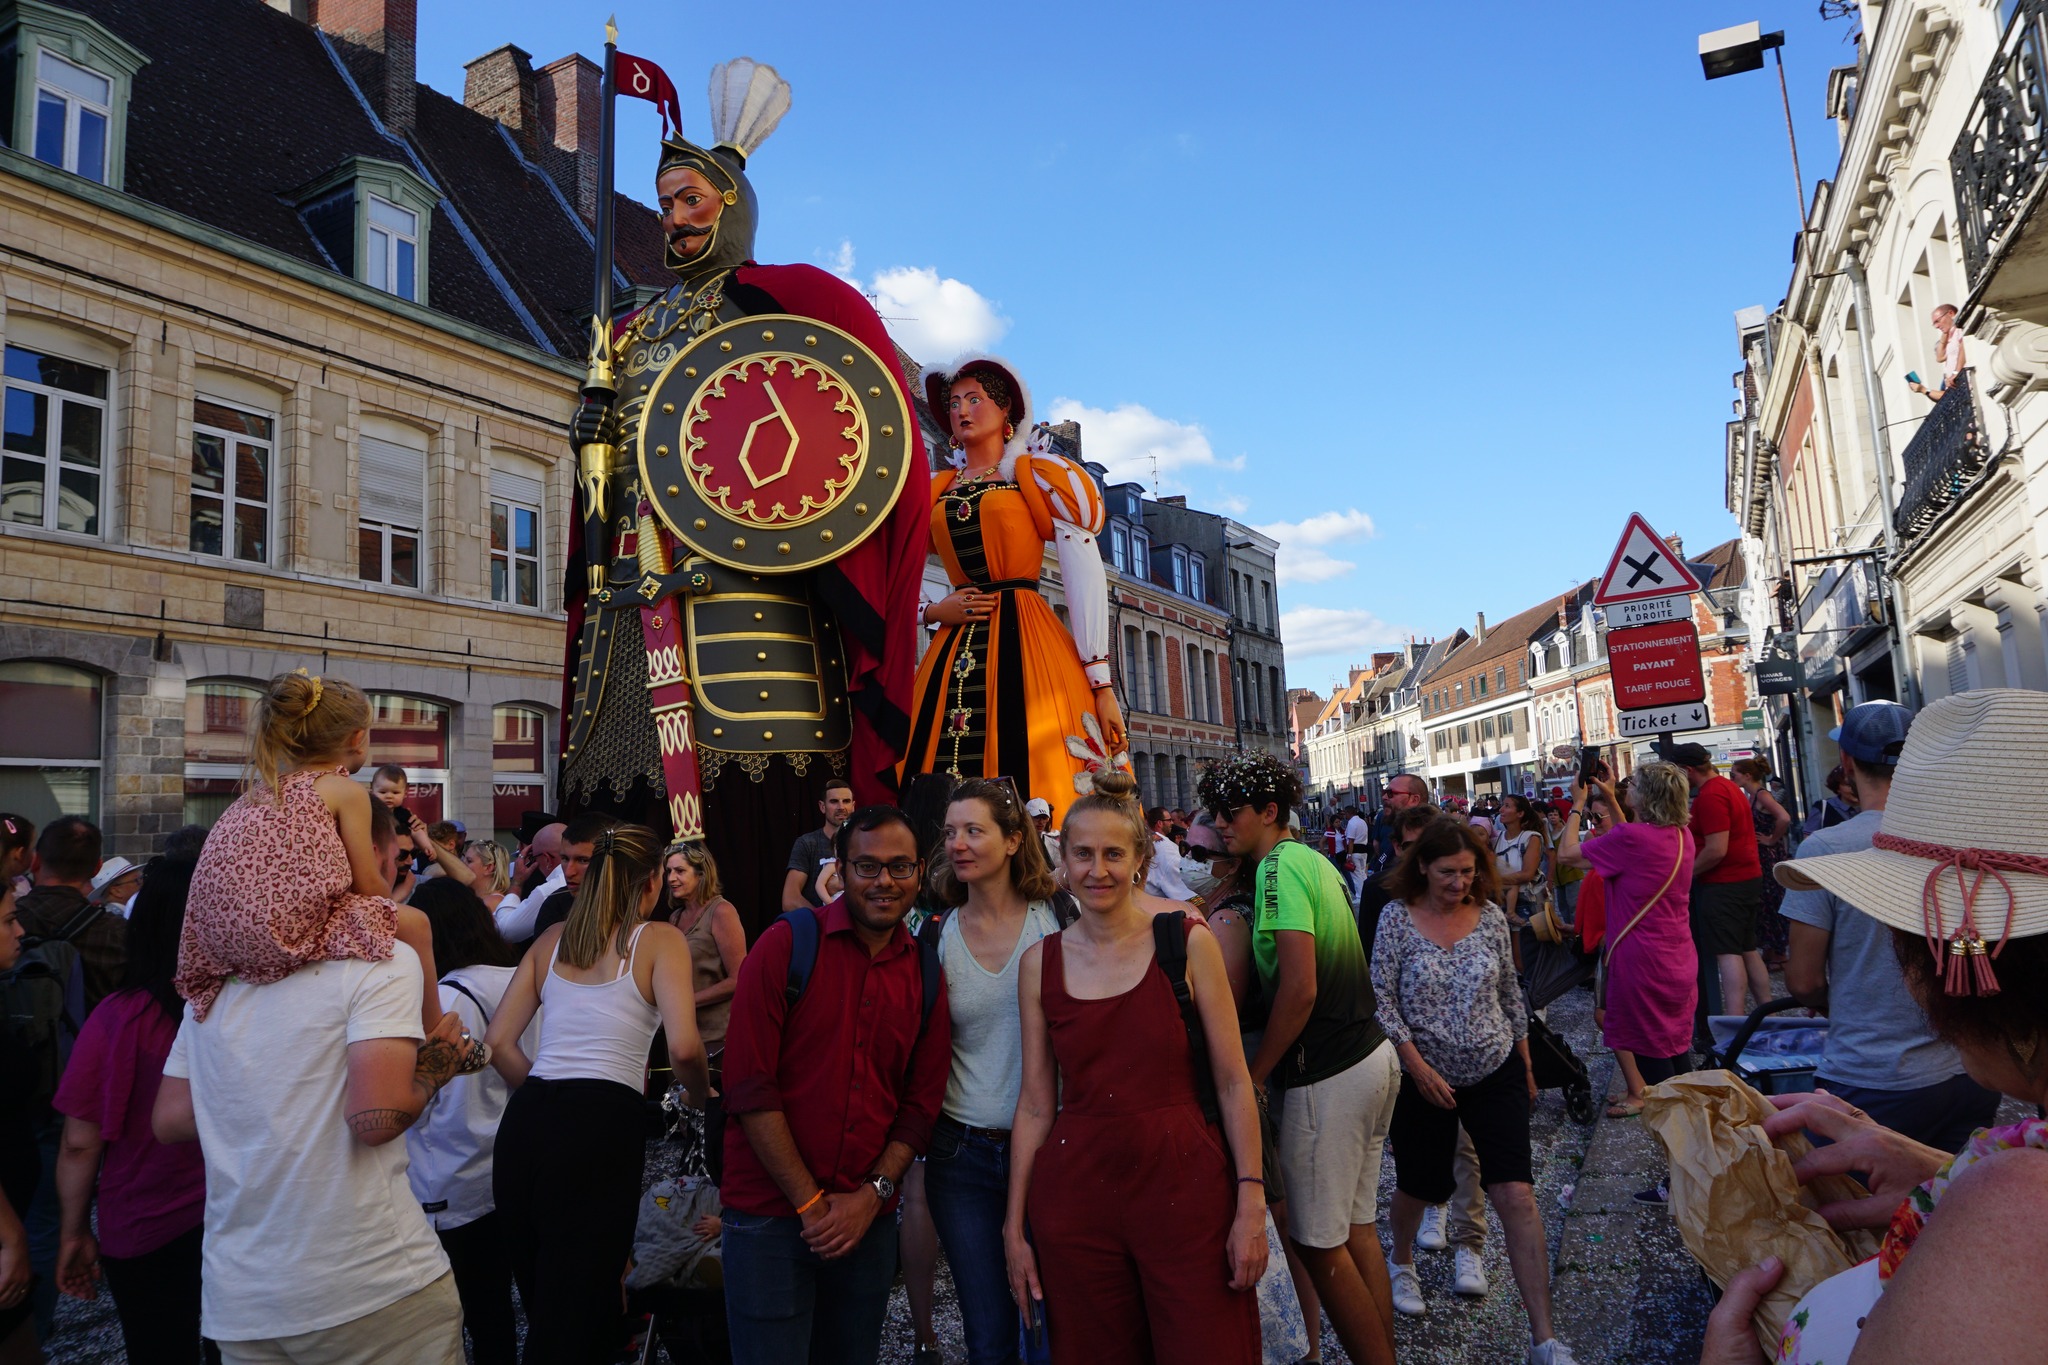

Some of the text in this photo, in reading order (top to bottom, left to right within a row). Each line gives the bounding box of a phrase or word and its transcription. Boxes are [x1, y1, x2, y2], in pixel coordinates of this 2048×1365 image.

[1624, 600, 1672, 613] PRIORITÉ
[1626, 610, 1673, 622] À DROITE
[1610, 634, 1693, 654] STATIONNEMENT
[1633, 659, 1676, 672] PAYANT
[1760, 671, 1784, 679] HAVAS
[1761, 676, 1793, 684] VOYAGES
[1624, 678, 1692, 694] TARIF ROUGE
[1621, 712, 1678, 731] Ticket
